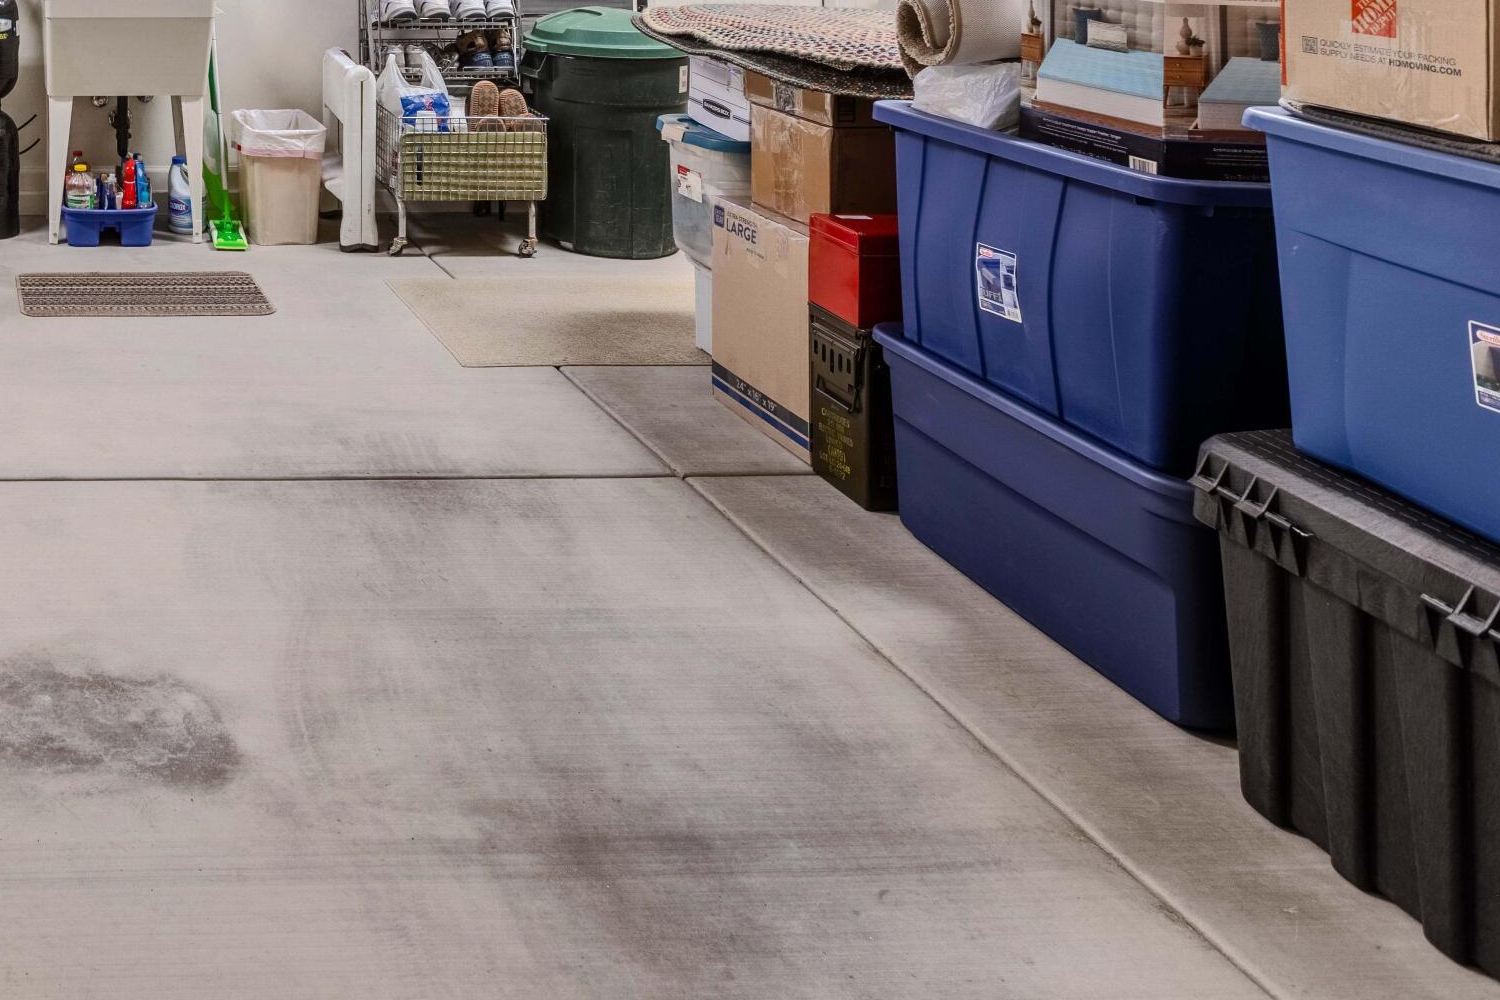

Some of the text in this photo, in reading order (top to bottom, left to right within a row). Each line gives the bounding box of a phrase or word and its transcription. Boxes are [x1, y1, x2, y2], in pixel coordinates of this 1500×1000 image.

[1368, 7, 1396, 35] DEPOT
[1319, 48, 1462, 77] SUPPLY NEEDS AT HDMOVING.COM
[1320, 38, 1456, 66] QUICKLY ESTIMATE YOUR PACKING
[726, 219, 757, 244] LARGE
